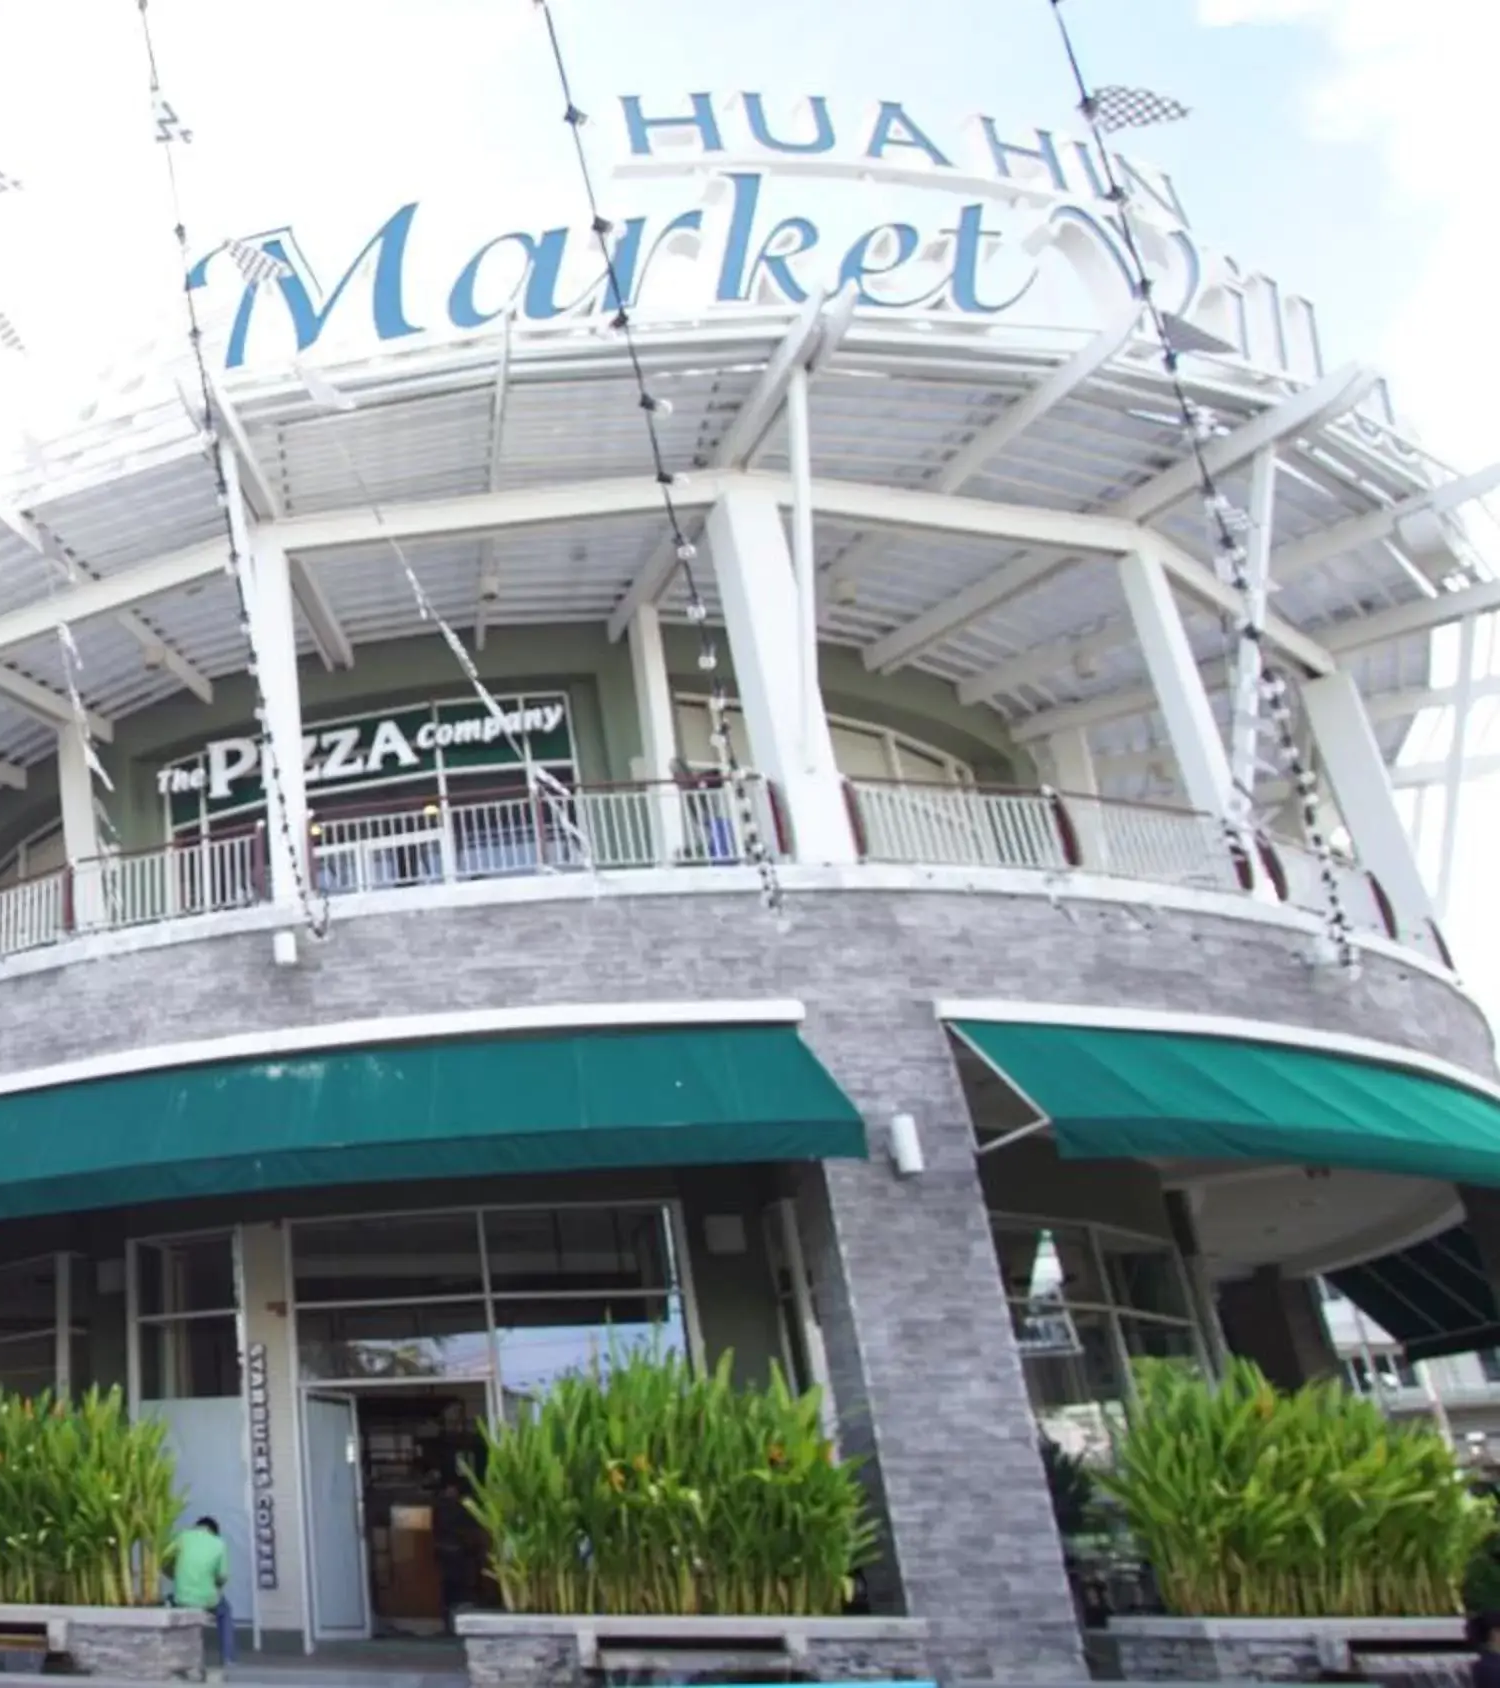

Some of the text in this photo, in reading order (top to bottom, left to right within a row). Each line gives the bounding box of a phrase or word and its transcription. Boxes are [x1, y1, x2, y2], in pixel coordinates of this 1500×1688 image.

[617, 91, 1192, 231] HUA HIN
[186, 173, 1041, 370] Market
[156, 767, 207, 794] The
[416, 703, 564, 749] Company
[250, 1342, 273, 1489] STARBUCKS
